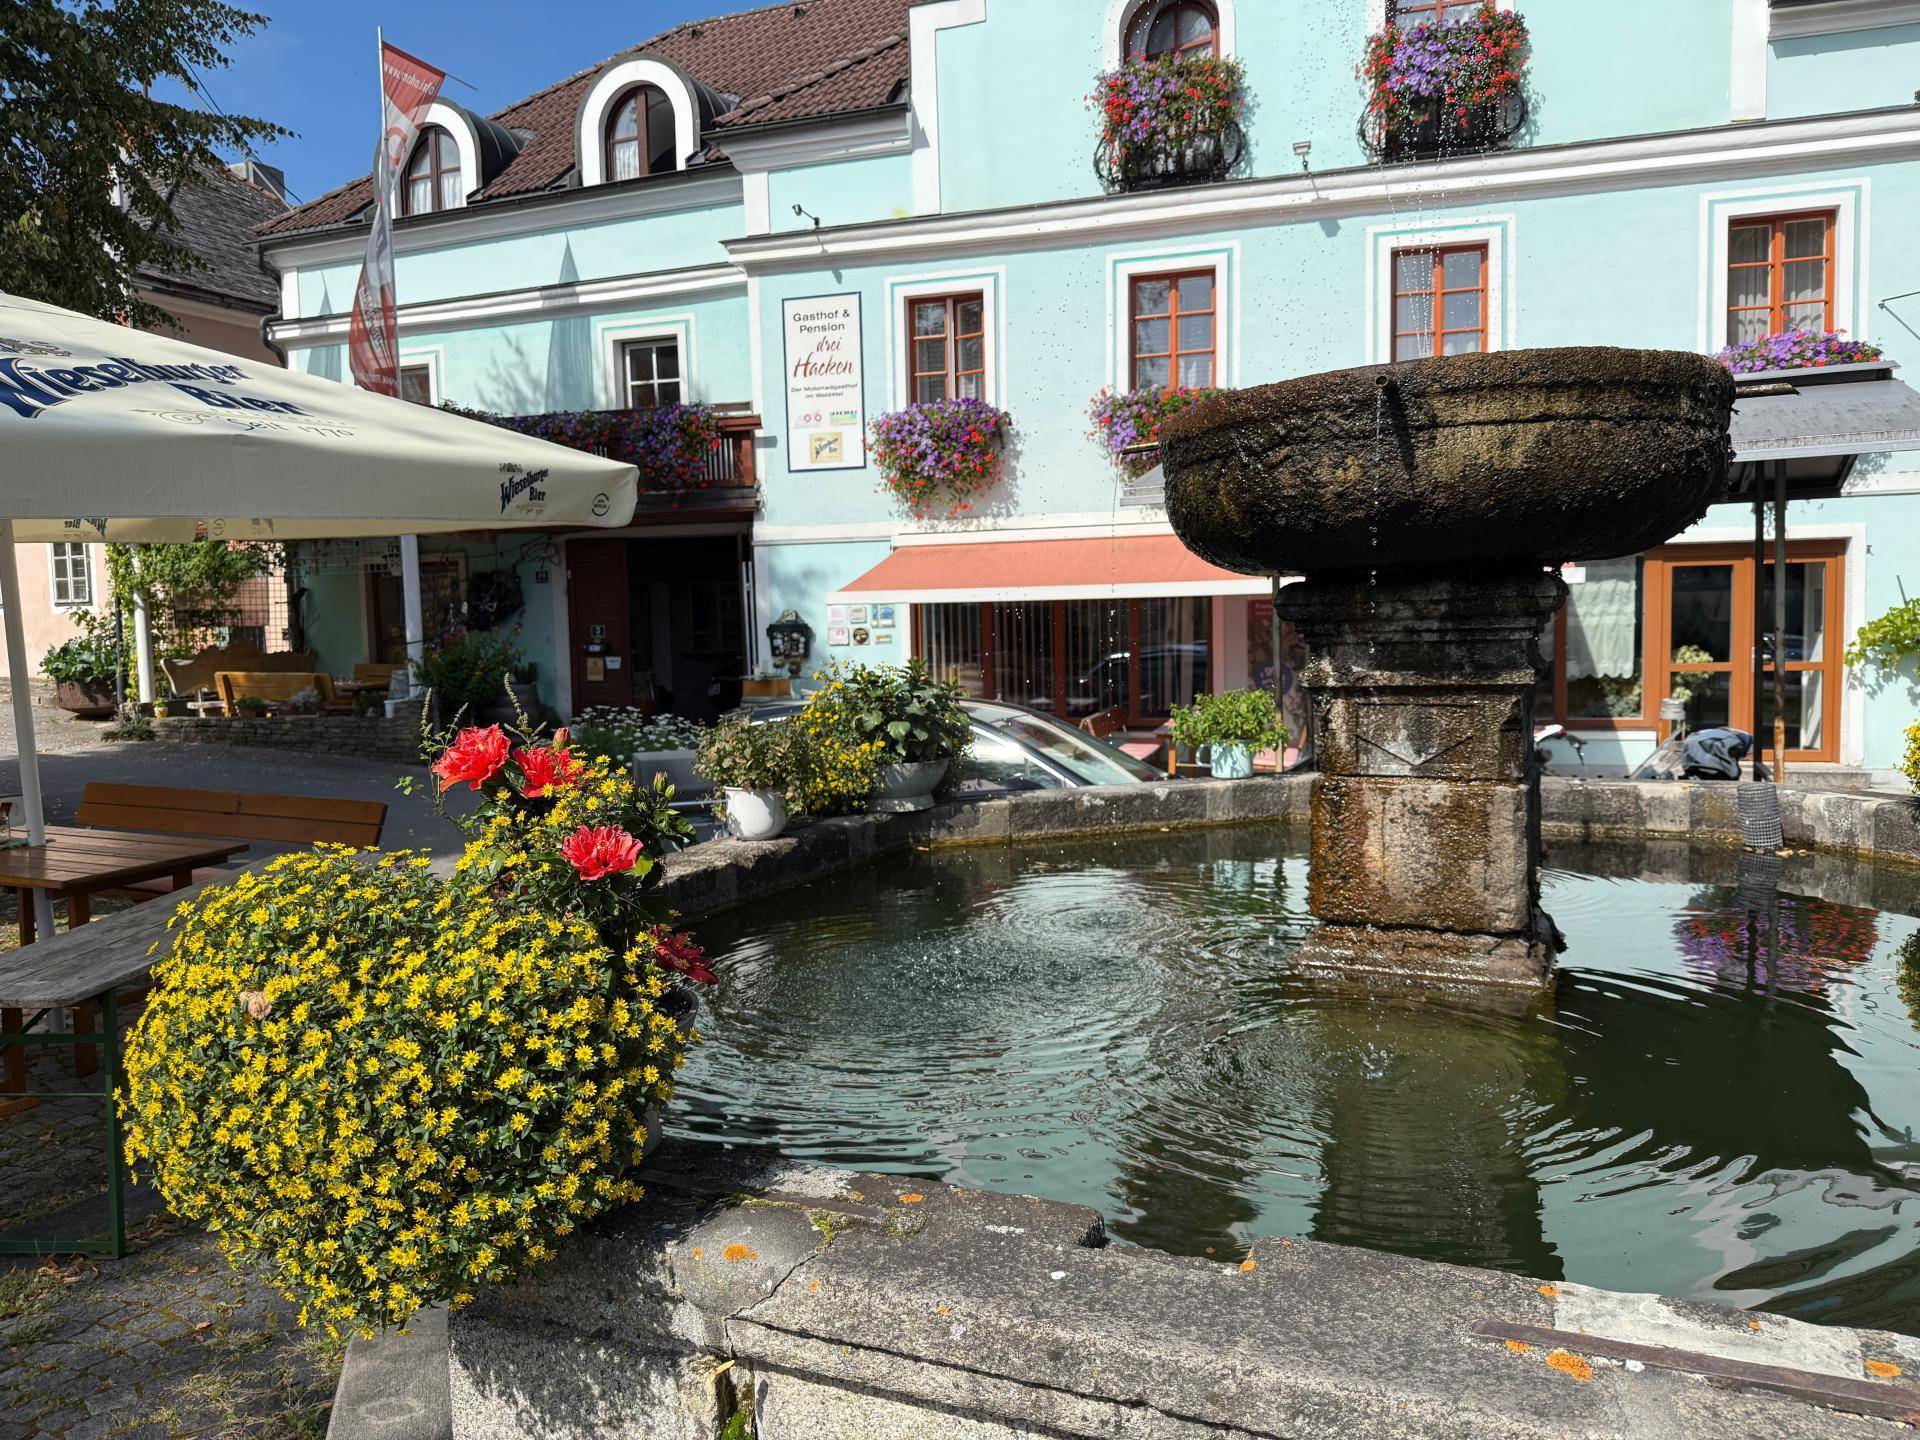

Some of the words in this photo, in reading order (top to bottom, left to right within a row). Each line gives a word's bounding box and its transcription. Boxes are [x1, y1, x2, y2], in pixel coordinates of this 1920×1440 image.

[793, 310, 838, 322] Gasthof
[842, 309, 850, 318] &
[799, 323, 845, 334] Pension
[816, 336, 843, 352] drei
[793, 351, 853, 378] Hacken
[168, 382, 315, 417] Bier
[500, 468, 549, 514] Wieselburger
[529, 487, 546, 501] Bier
